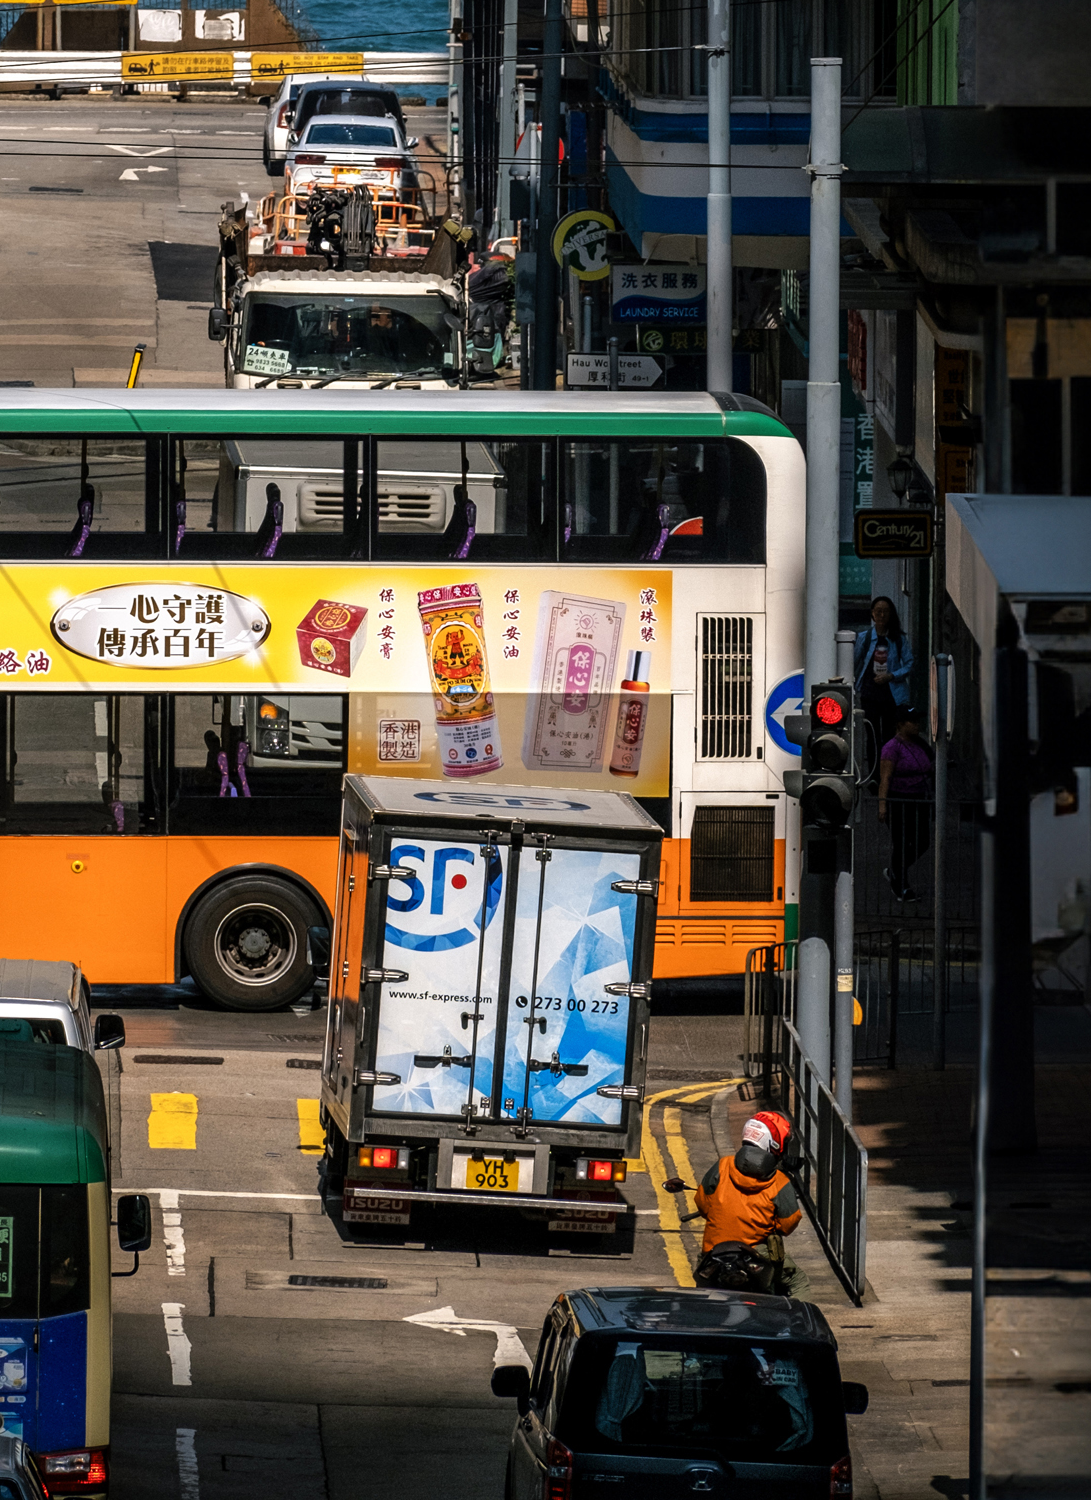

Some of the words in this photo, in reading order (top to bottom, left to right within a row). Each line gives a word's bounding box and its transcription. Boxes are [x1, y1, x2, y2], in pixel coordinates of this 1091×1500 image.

[621, 272, 698, 289] 洗衣服務
[620, 307, 660, 317] LAUNDRY
[663, 307, 699, 317] SERVICE
[670, 330, 760, 349] 環球業
[572, 358, 590, 367] Hau
[619, 360, 642, 368] treet
[855, 413, 874, 509] 香港置
[863, 519, 915, 537] Century
[909, 531, 925, 548] 21
[98, 593, 225, 625] 一心守護
[639, 589, 658, 642] 滾珠裝
[377, 588, 396, 660] 保心安膏
[502, 588, 521, 660] 保心安油
[97, 628, 225, 658] 傳承百年
[566, 651, 591, 708] 保心安
[380, 722, 417, 740] 香港
[624, 704, 641, 741] 保心安
[380, 740, 417, 760] 製造
[389, 990, 493, 1005] www.sf-express.com
[533, 996, 562, 1012] 273
[566, 998, 586, 1013] 00
[590, 999, 619, 1015] 273
[483, 1158, 506, 1175] YH
[475, 1172, 509, 1189] 903
[349, 1197, 404, 1210] ISUZU
